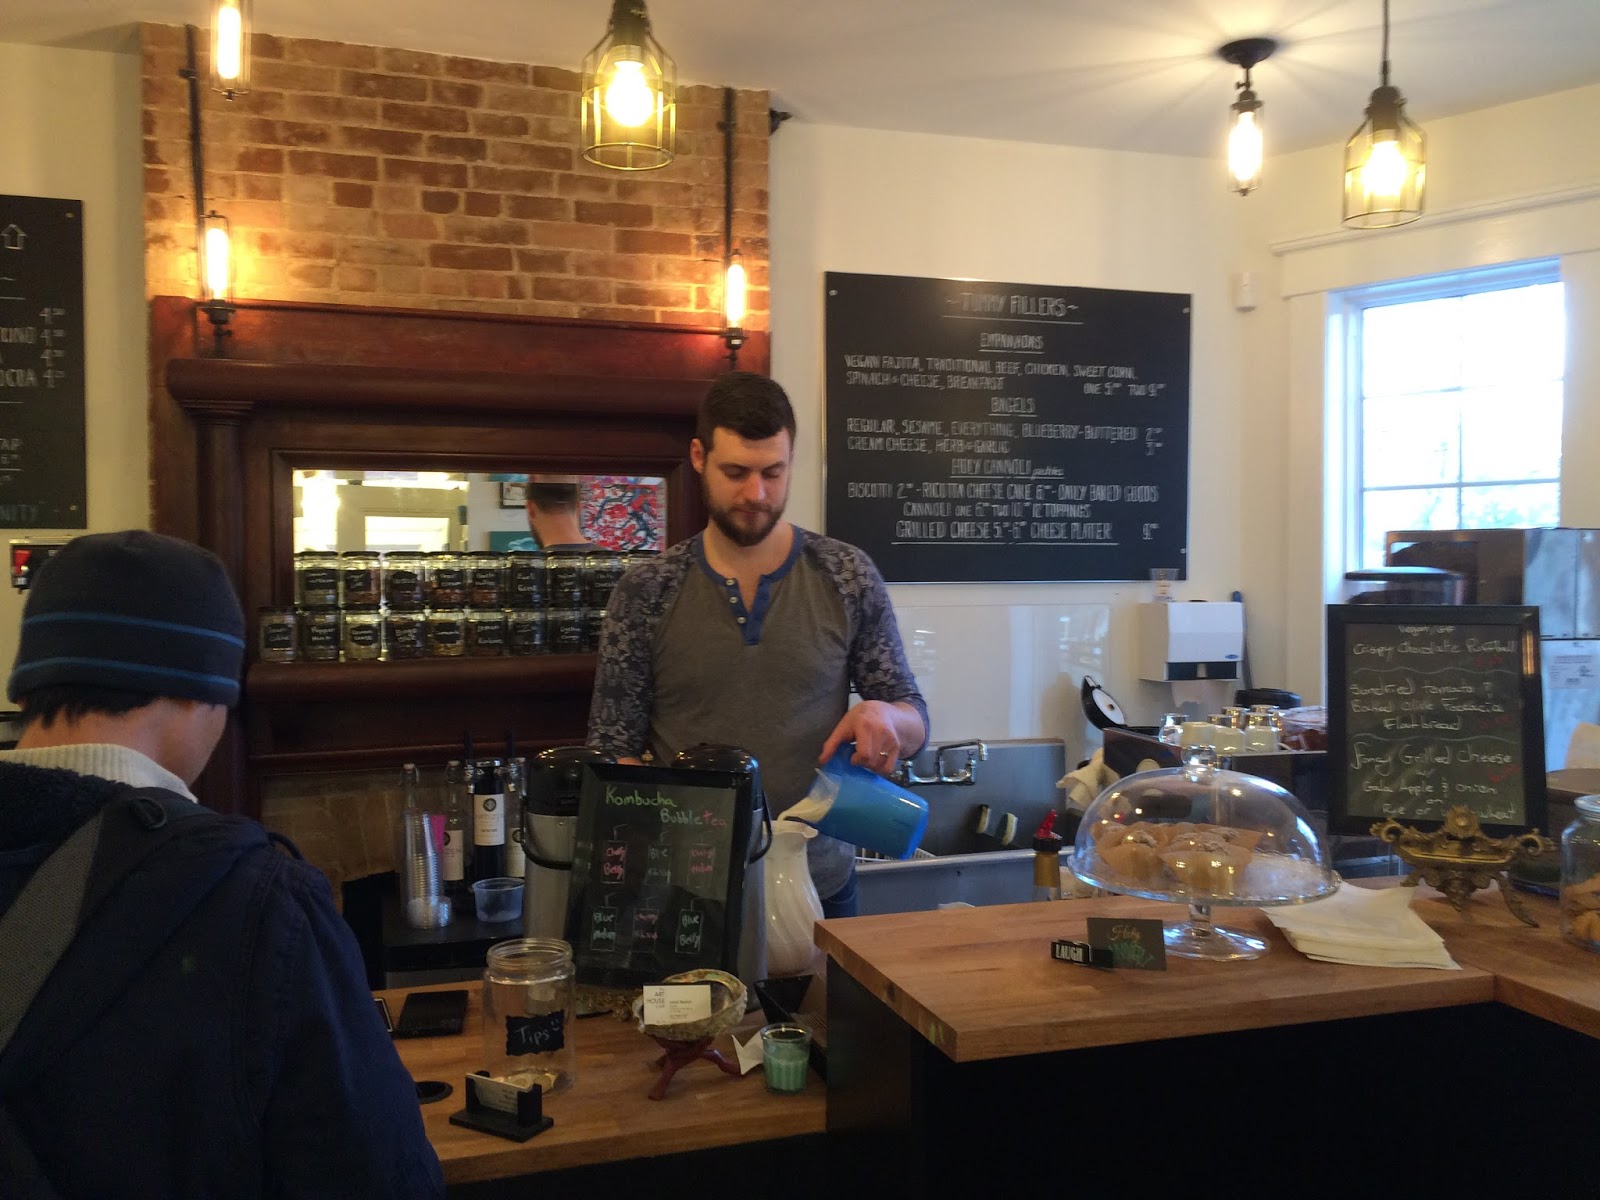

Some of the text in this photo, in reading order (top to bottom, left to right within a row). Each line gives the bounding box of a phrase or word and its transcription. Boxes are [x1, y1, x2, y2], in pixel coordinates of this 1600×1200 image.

[1010, 295, 1068, 317] FILLERS
[844, 354, 881, 369] VEGAN
[1025, 362, 1071, 378] CHICKEN,
[1073, 364, 1108, 378] SWEET
[847, 436, 885, 451] CREAM
[966, 482, 1005, 500] CHEESE
[1006, 483, 1034, 501] CAKE
[1123, 485, 1160, 502] GOODS
[895, 520, 947, 539] GRILLED
[950, 521, 991, 539] CHEESE
[1030, 522, 1069, 540] CHEESE
[605, 784, 678, 808] Kombucha
[1055, 943, 1084, 962] LAUGH
[514, 1024, 549, 1046] Tips
